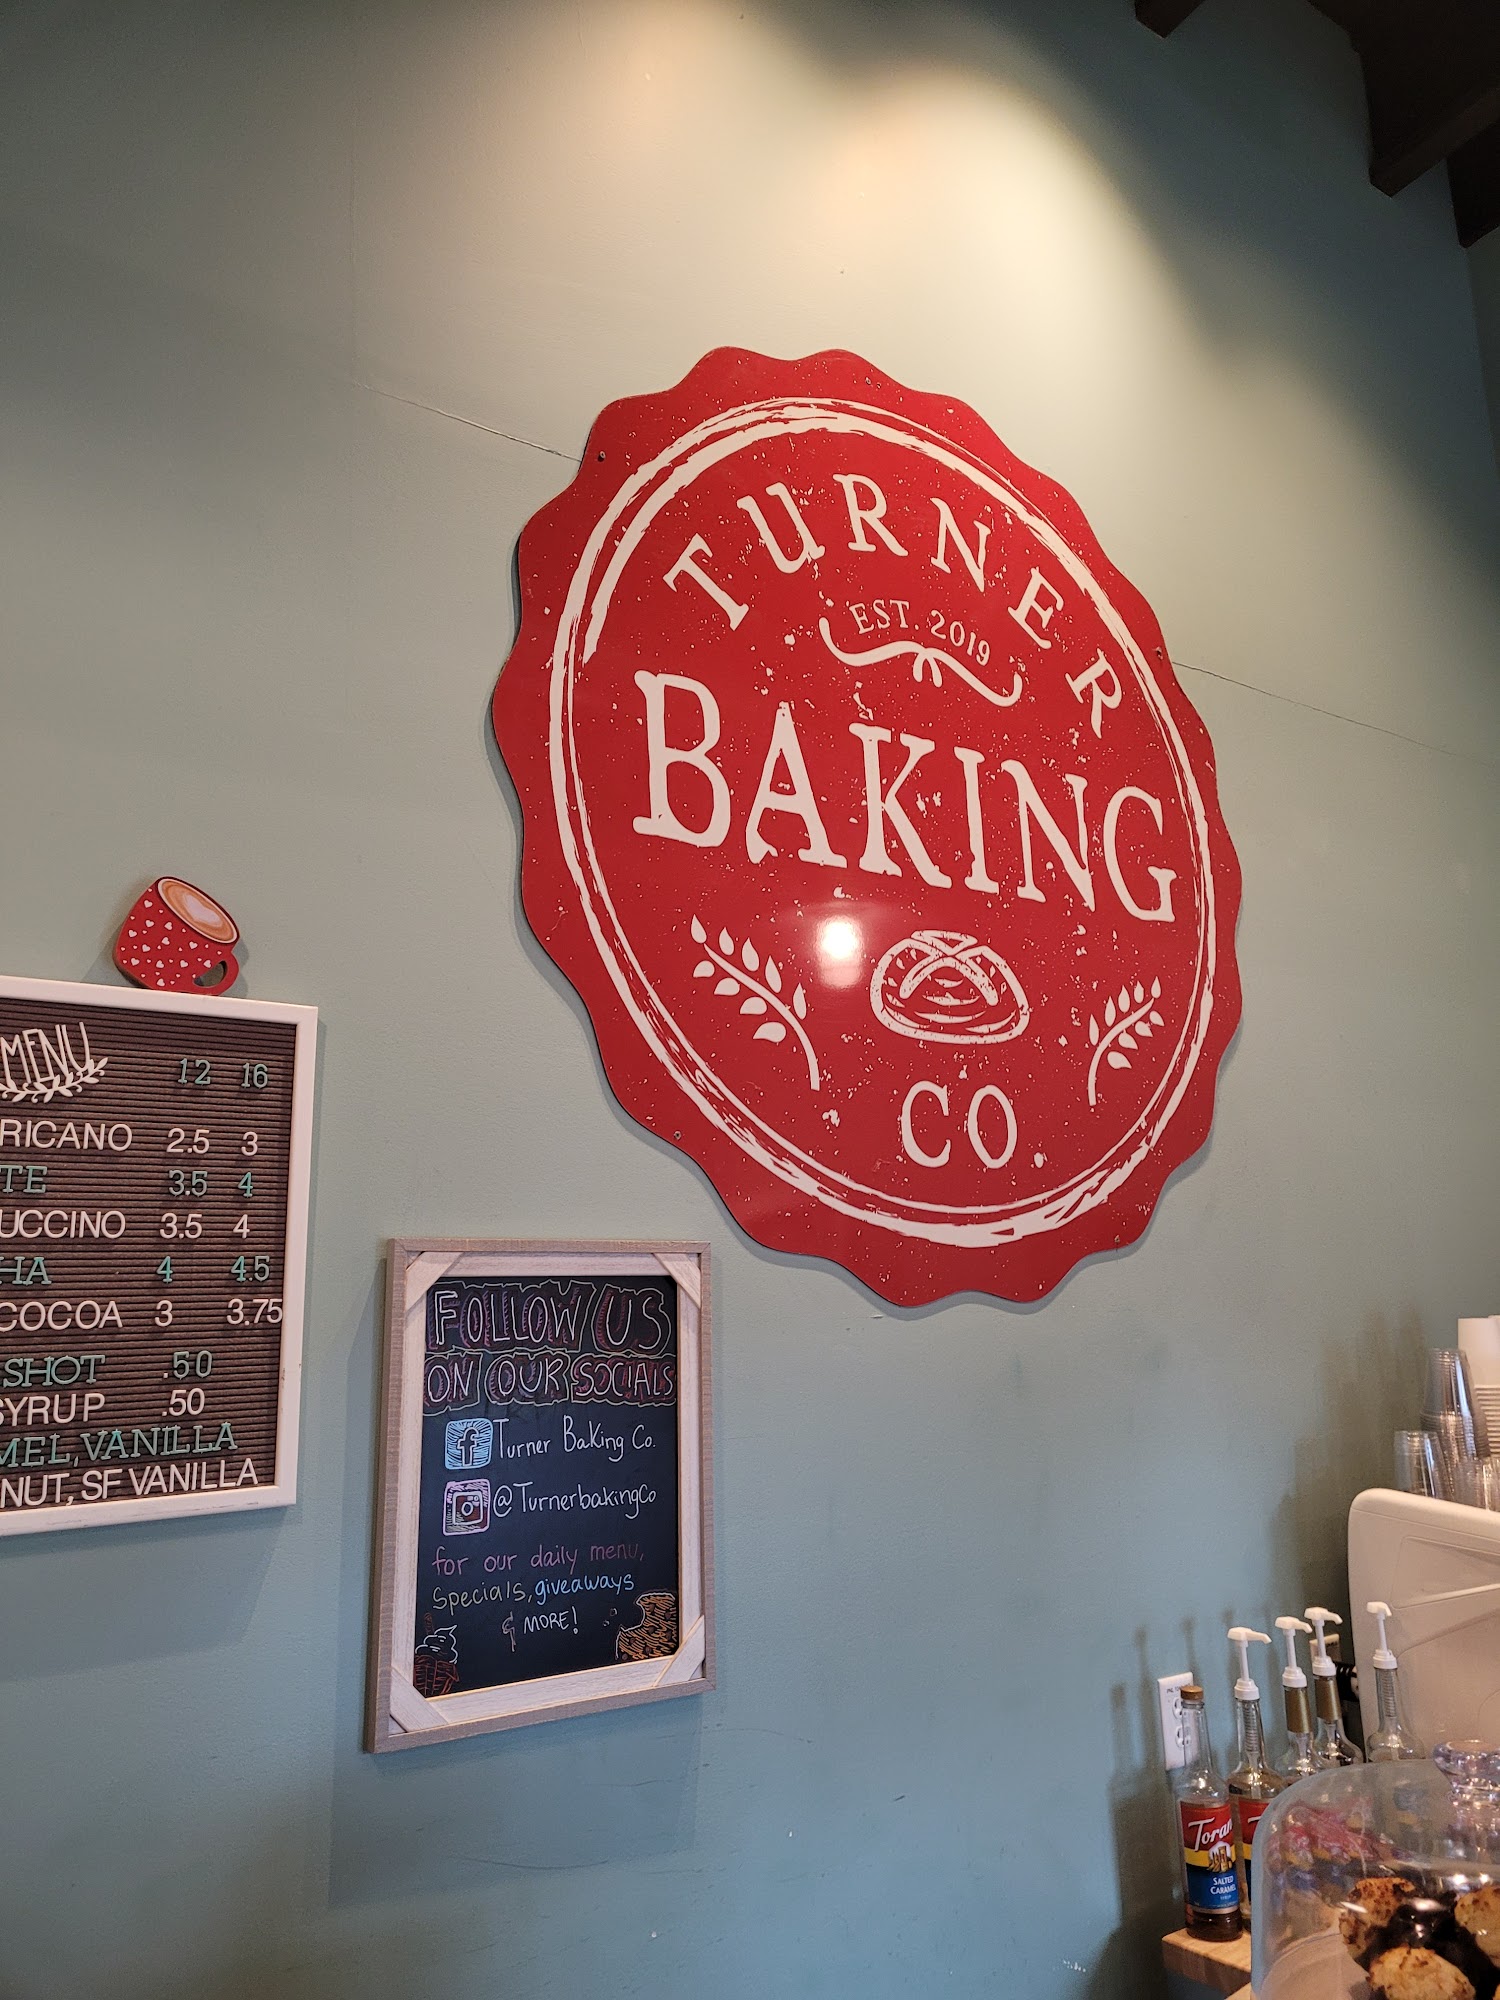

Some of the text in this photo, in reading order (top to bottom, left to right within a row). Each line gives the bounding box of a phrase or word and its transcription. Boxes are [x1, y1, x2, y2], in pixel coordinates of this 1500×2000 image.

[662, 474, 1123, 738] TURNER
[848, 599, 991, 667] EST. 2019
[632, 670, 1177, 923] BAKING
[0, 1022, 91, 1085] MENU
[177, 1058, 269, 1089] 12 16
[0, 1118, 259, 1157] RICANO 2.5 3
[900, 1080, 1048, 1170] CO.
[0, 1165, 254, 1198] TE 3.5 4
[0, 1209, 251, 1239] UCCINO 3.5 4
[156, 1256, 174, 1283] 4
[230, 1255, 271, 1283] 4.5
[0, 1298, 284, 1332] COCOA 3 3.75
[432, 1288, 663, 1350] FOLLOW US
[2, 1350, 214, 1388] SHOT .50
[427, 1358, 675, 1403] ON OUR SOCIALS
[0, 1387, 206, 1427] YRUP .50
[80, 1421, 239, 1461] VANILLA
[493, 1417, 552, 1460] Turner
[631, 1423, 657, 1450] Co.
[0, 1457, 259, 1508] NUT, SF VANILLA
[432, 1541, 645, 1576] for our daily menu,
[534, 1572, 636, 1605] giveaways
[501, 1606, 579, 1652] & MORE!
[1212, 1875, 1234, 1886] SALTED
